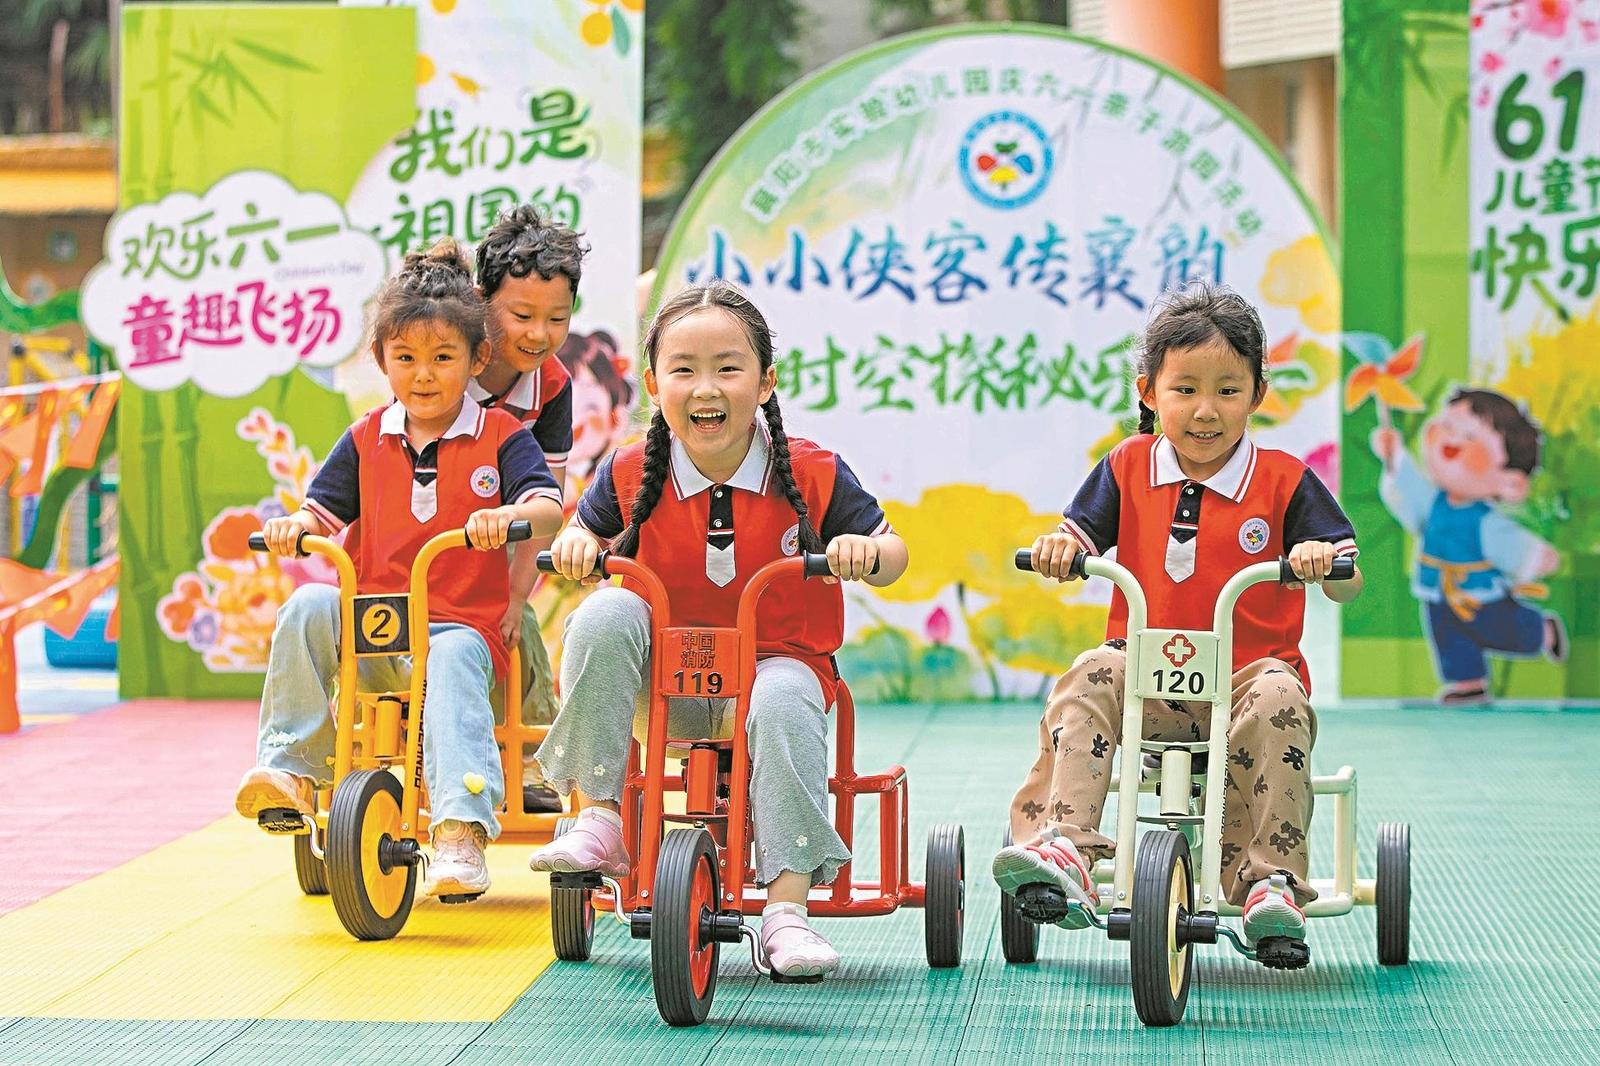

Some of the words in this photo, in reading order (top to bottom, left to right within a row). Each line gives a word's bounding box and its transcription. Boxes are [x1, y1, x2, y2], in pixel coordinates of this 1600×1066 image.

[1495, 70, 1584, 161] 61
[390, 89, 591, 182] 我们是
[121, 202, 340, 280] 欢乐六一
[122, 280, 341, 368] 童趣飞扬
[370, 608, 392, 639] 2
[682, 631, 716, 650] 中国
[681, 650, 716, 669] 消防
[674, 670, 723, 695] 119
[1152, 669, 1205, 695] 120
